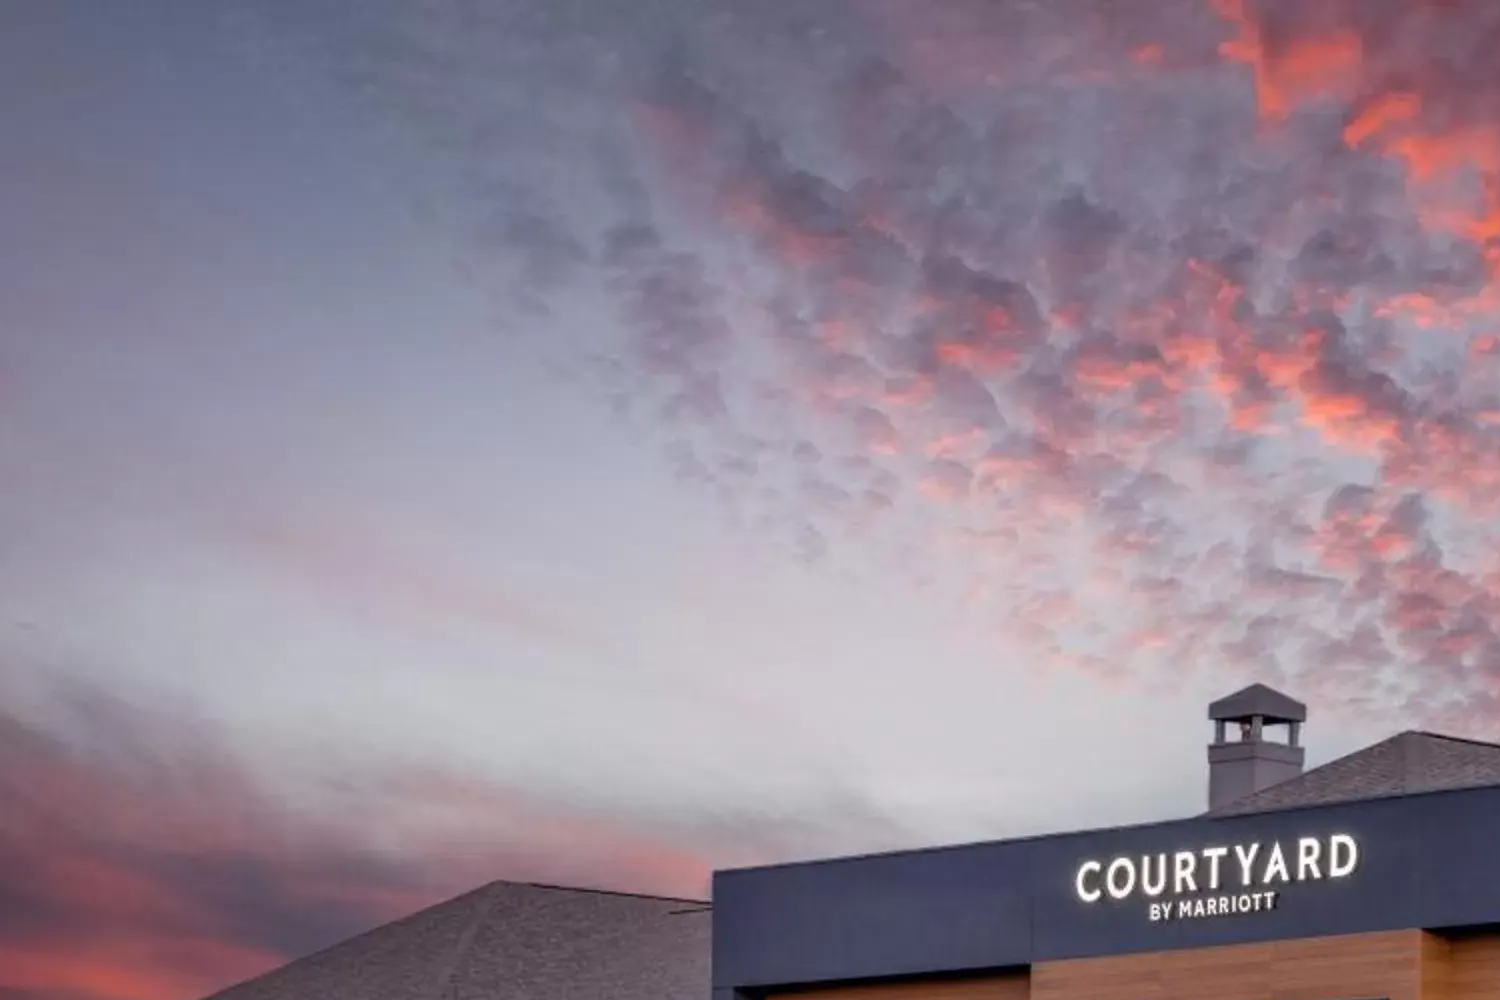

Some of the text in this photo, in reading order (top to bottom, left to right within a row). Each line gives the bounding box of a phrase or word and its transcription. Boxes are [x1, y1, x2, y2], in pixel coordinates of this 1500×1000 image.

[1076, 834, 1358, 902] COURTYARD
[1149, 891, 1276, 921] BY MARRIOTT
